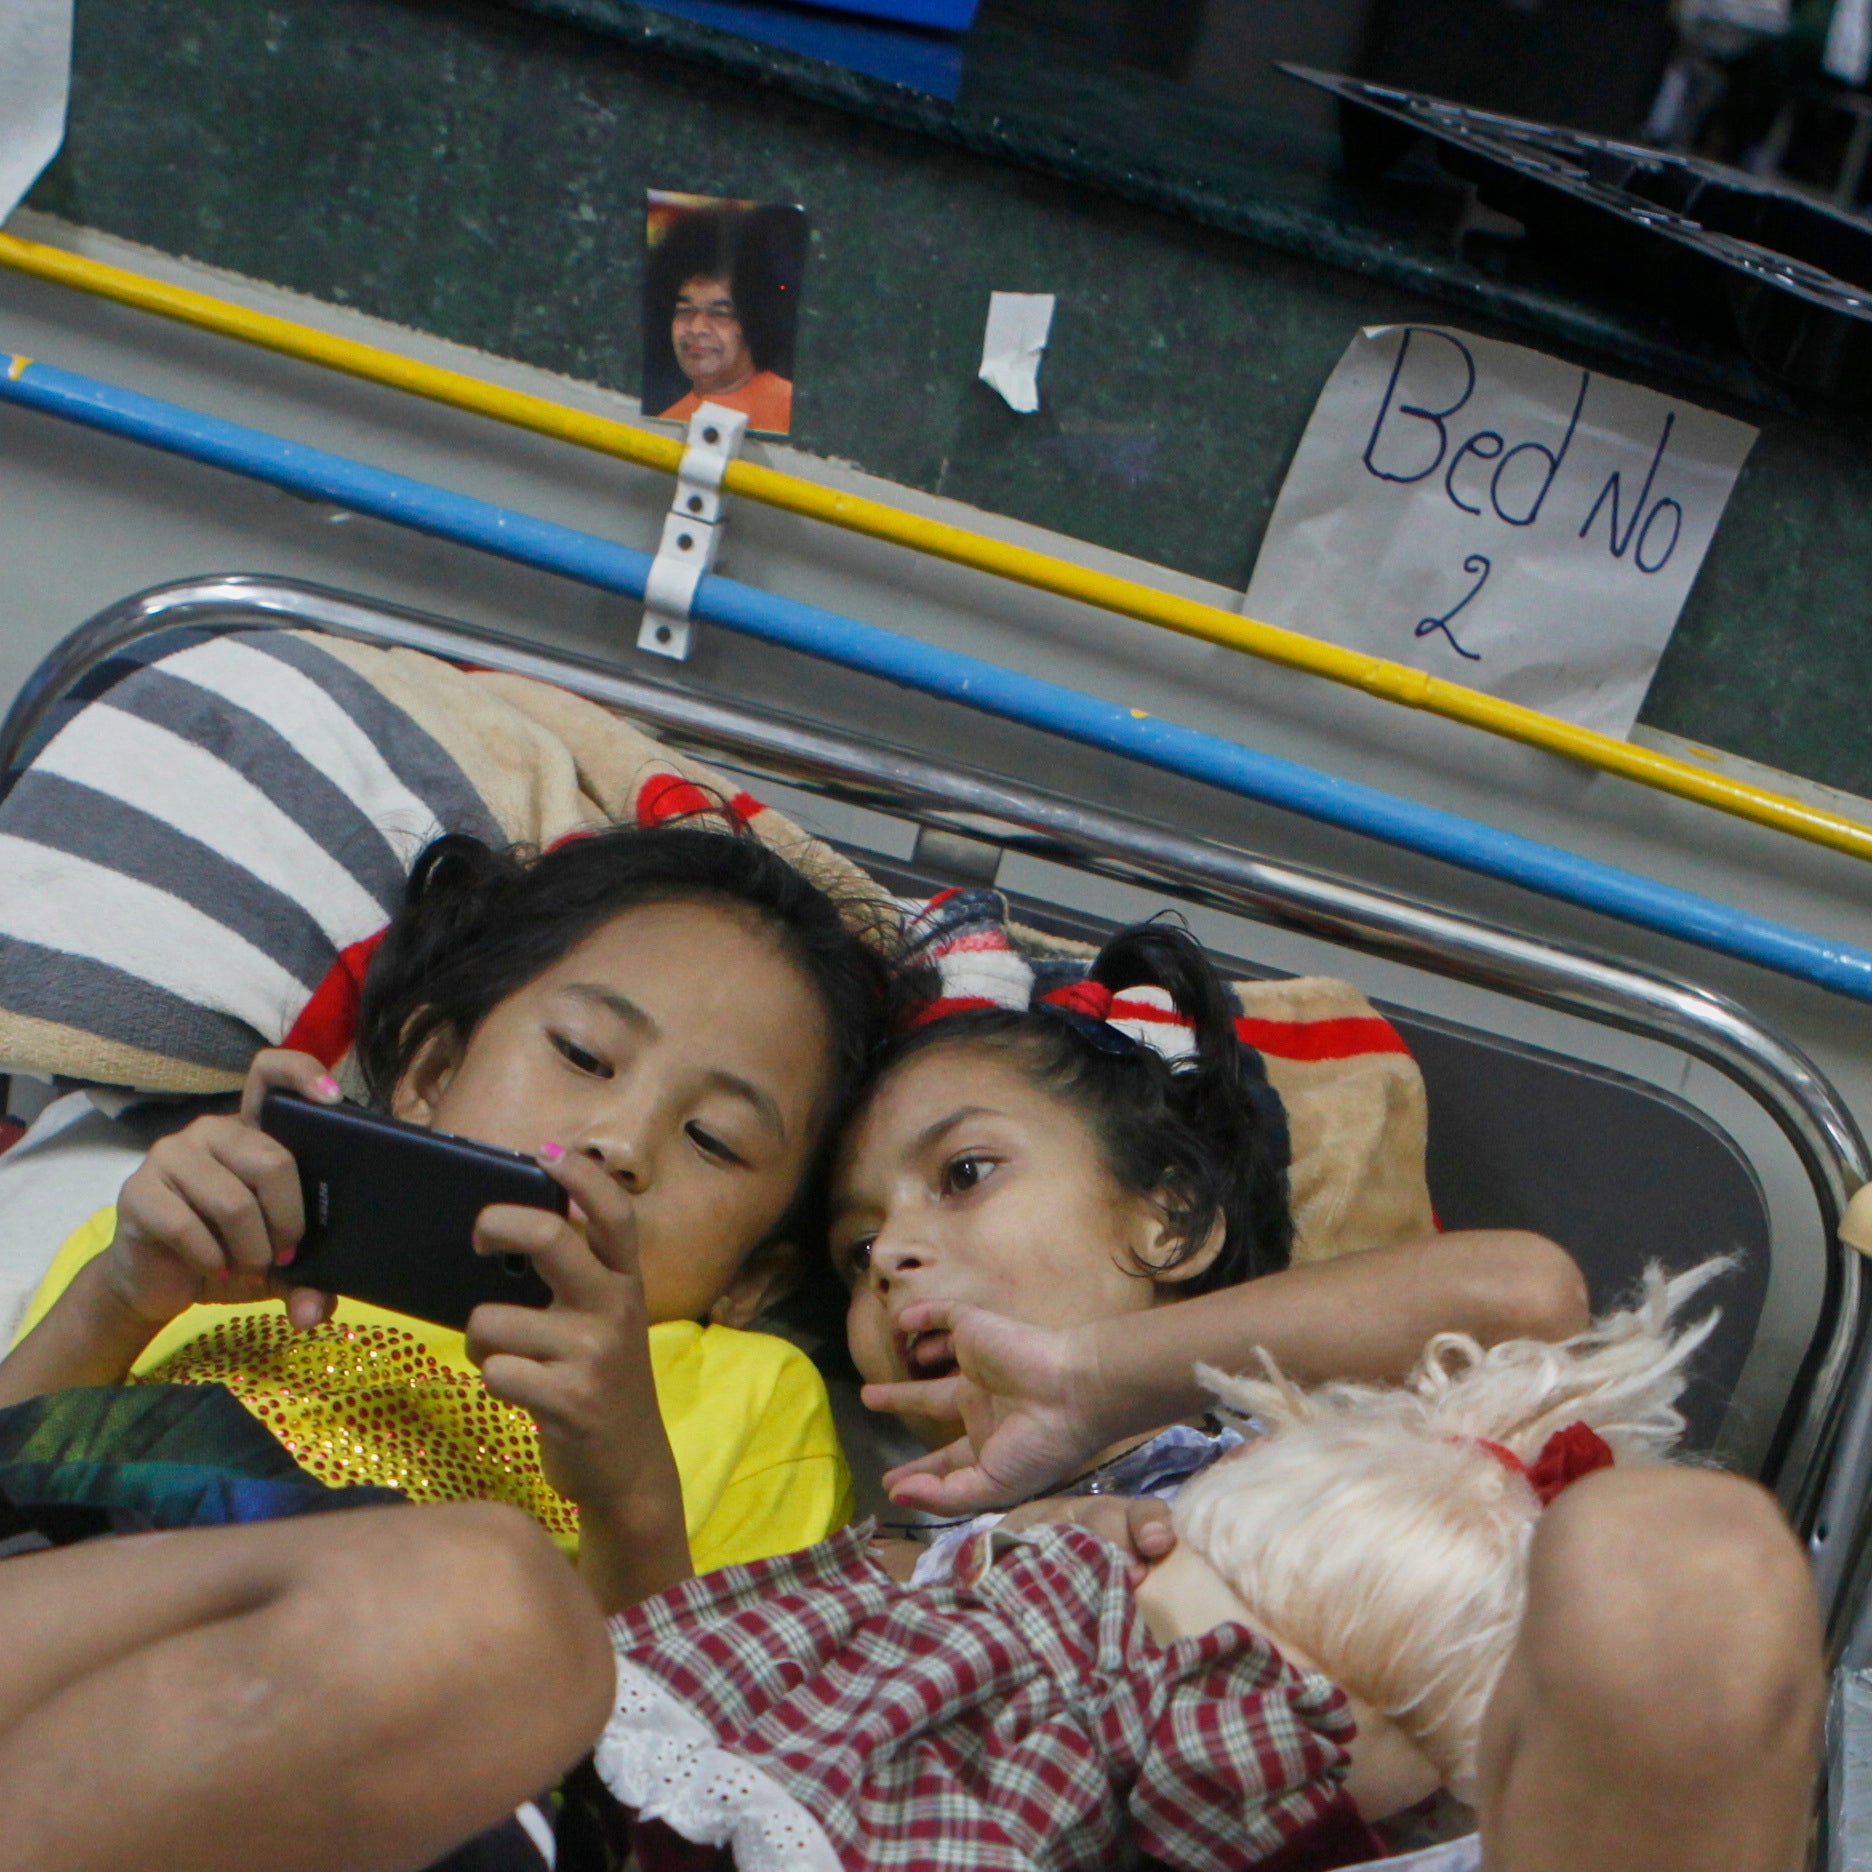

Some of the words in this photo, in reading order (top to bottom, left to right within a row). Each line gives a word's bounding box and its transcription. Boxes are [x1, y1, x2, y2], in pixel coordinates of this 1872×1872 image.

[1363, 326, 1590, 526] Bed
[1579, 411, 1683, 573] No
[1414, 554, 1492, 661] 2
